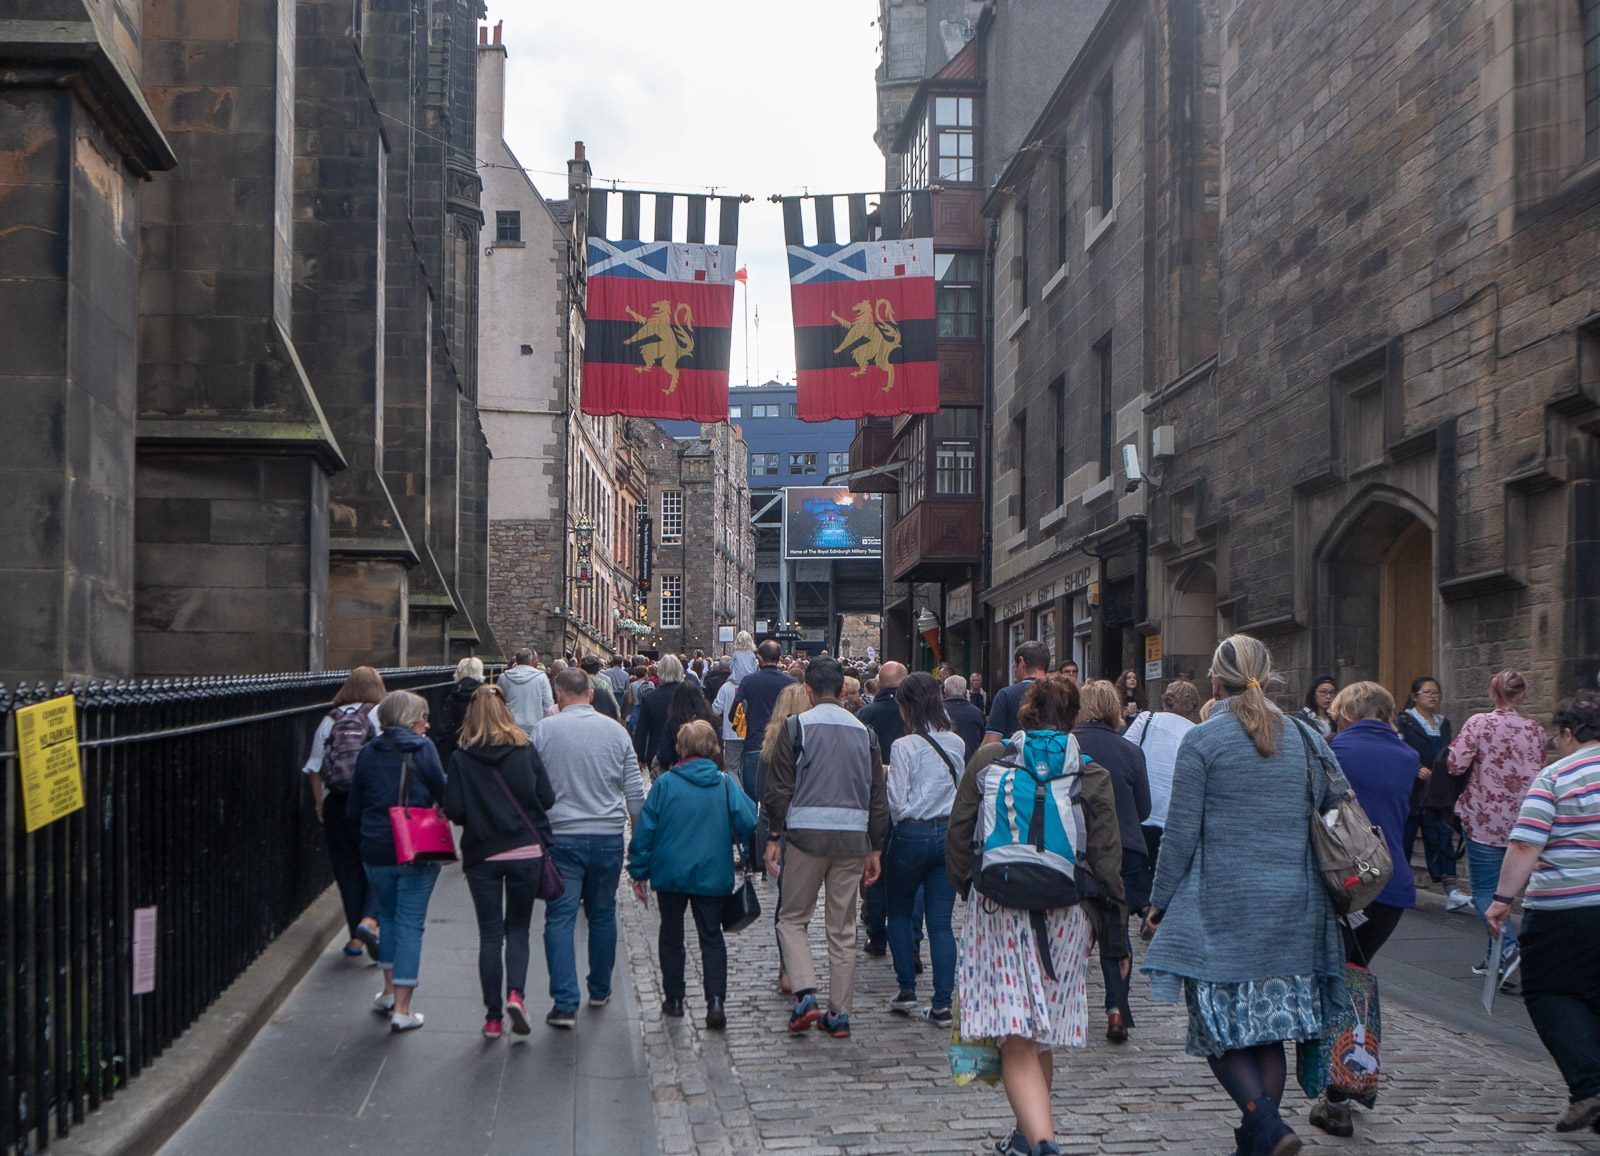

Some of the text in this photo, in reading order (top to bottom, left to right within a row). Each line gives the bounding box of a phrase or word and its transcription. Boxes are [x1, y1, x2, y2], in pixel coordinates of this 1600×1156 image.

[1003, 567, 1091, 618] CASTLE GIFT SHOP
